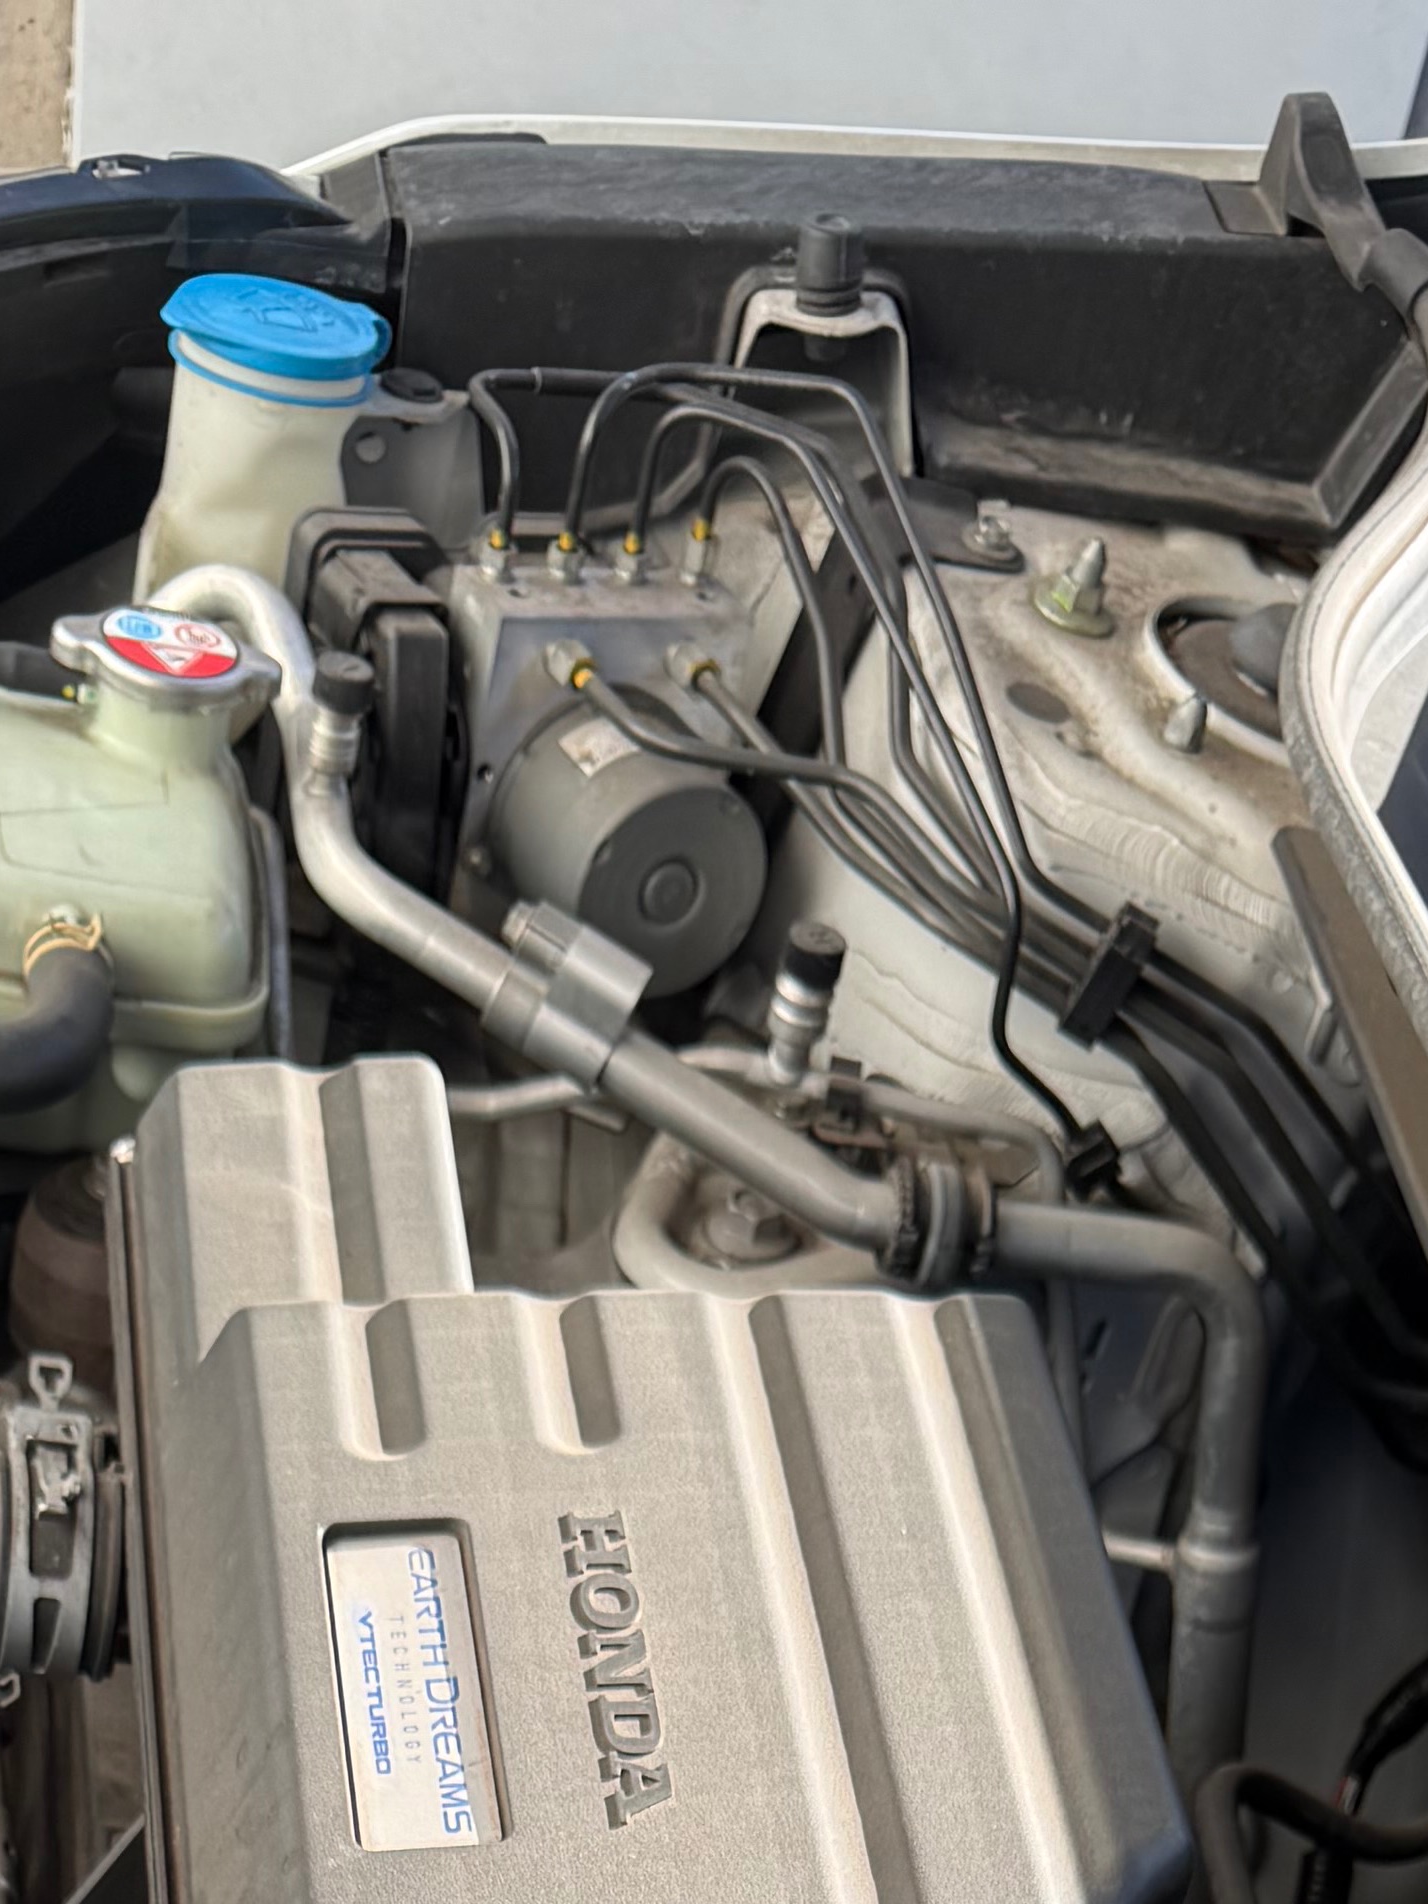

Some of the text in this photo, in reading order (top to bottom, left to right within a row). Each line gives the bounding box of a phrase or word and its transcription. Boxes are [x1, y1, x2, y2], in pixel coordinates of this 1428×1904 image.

[356, 1609, 391, 1776] VTEC TURBO
[389, 1615, 422, 1765] TECHNOLOGY
[407, 1546, 473, 1835] EARTH DREAMS
[558, 1508, 674, 1830] HONDA
